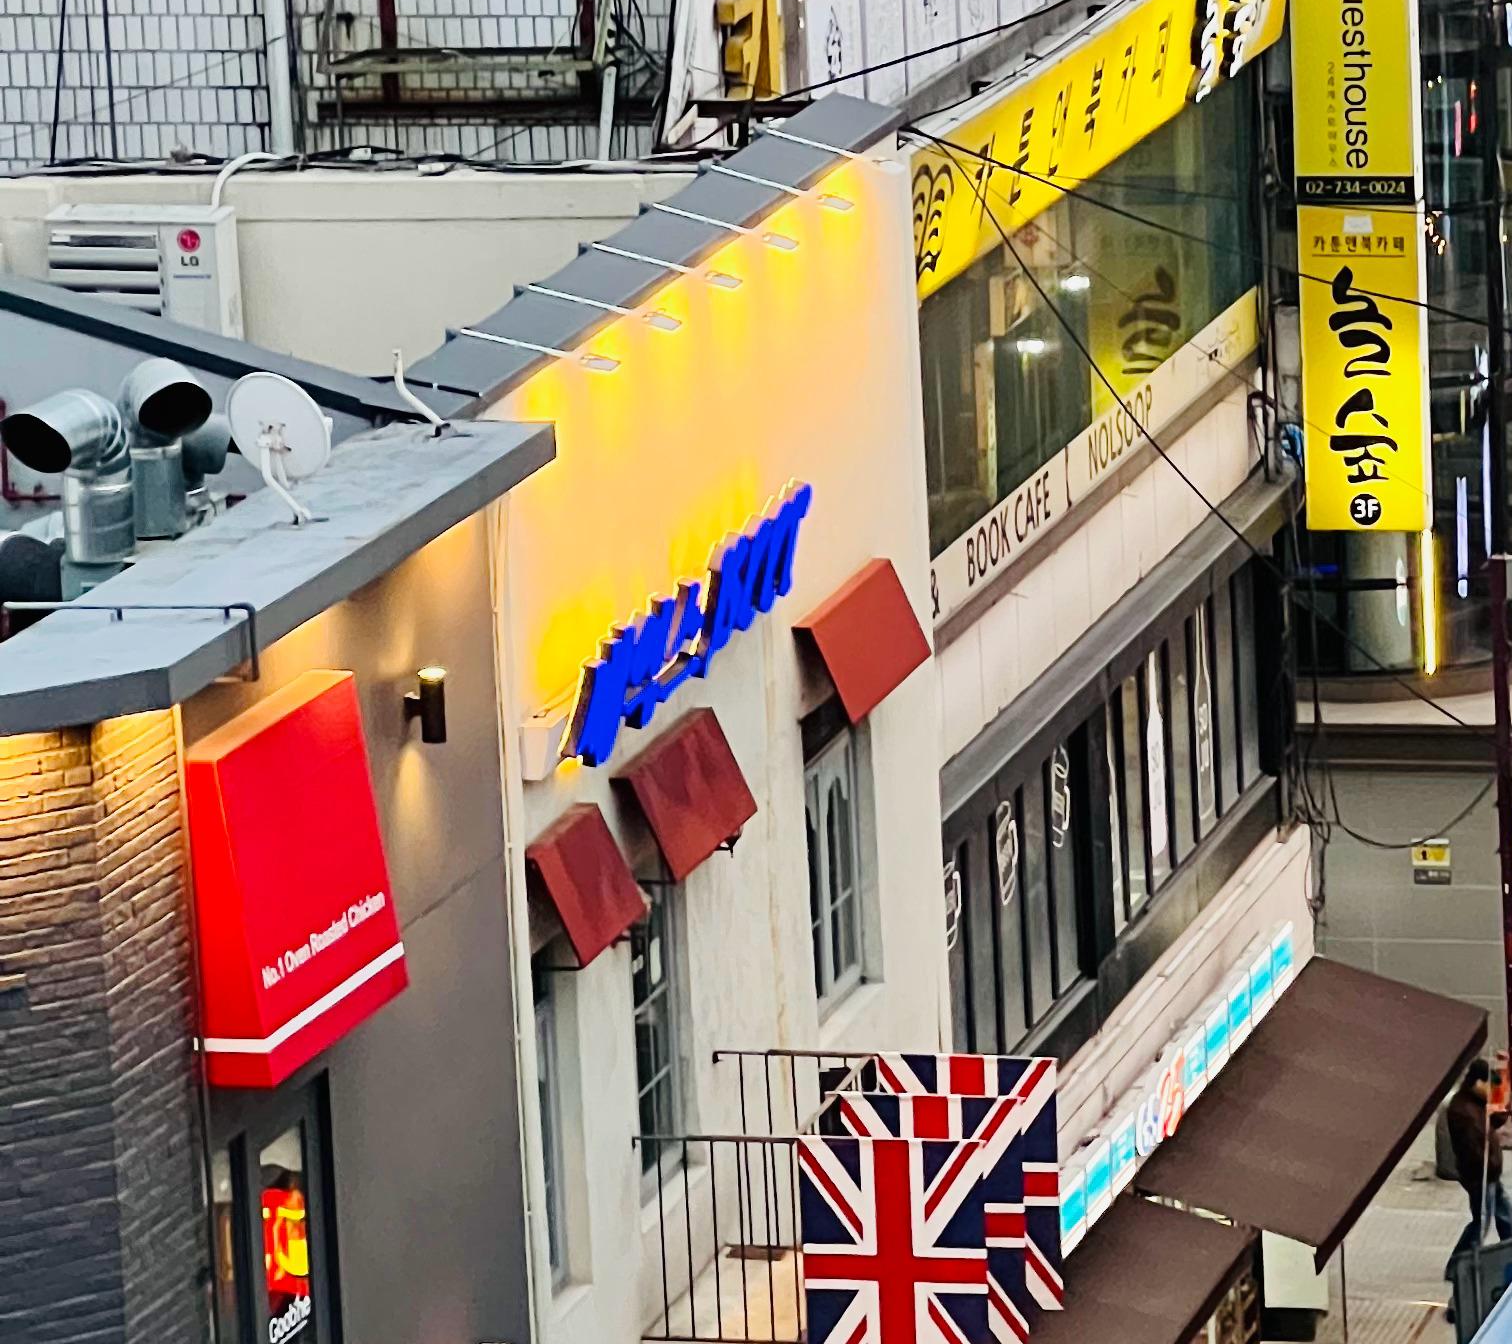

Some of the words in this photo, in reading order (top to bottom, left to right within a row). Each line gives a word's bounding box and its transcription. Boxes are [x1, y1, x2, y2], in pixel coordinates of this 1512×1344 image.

[1305, 181, 1406, 195] 02-734-0024
[1312, 235, 1406, 253] 카툰앤북카페
[181, 257, 199, 266] LG
[1354, 499, 1379, 519] 3F
[967, 507, 1012, 587] BOOK
[1014, 470, 1051, 544] CAFE
